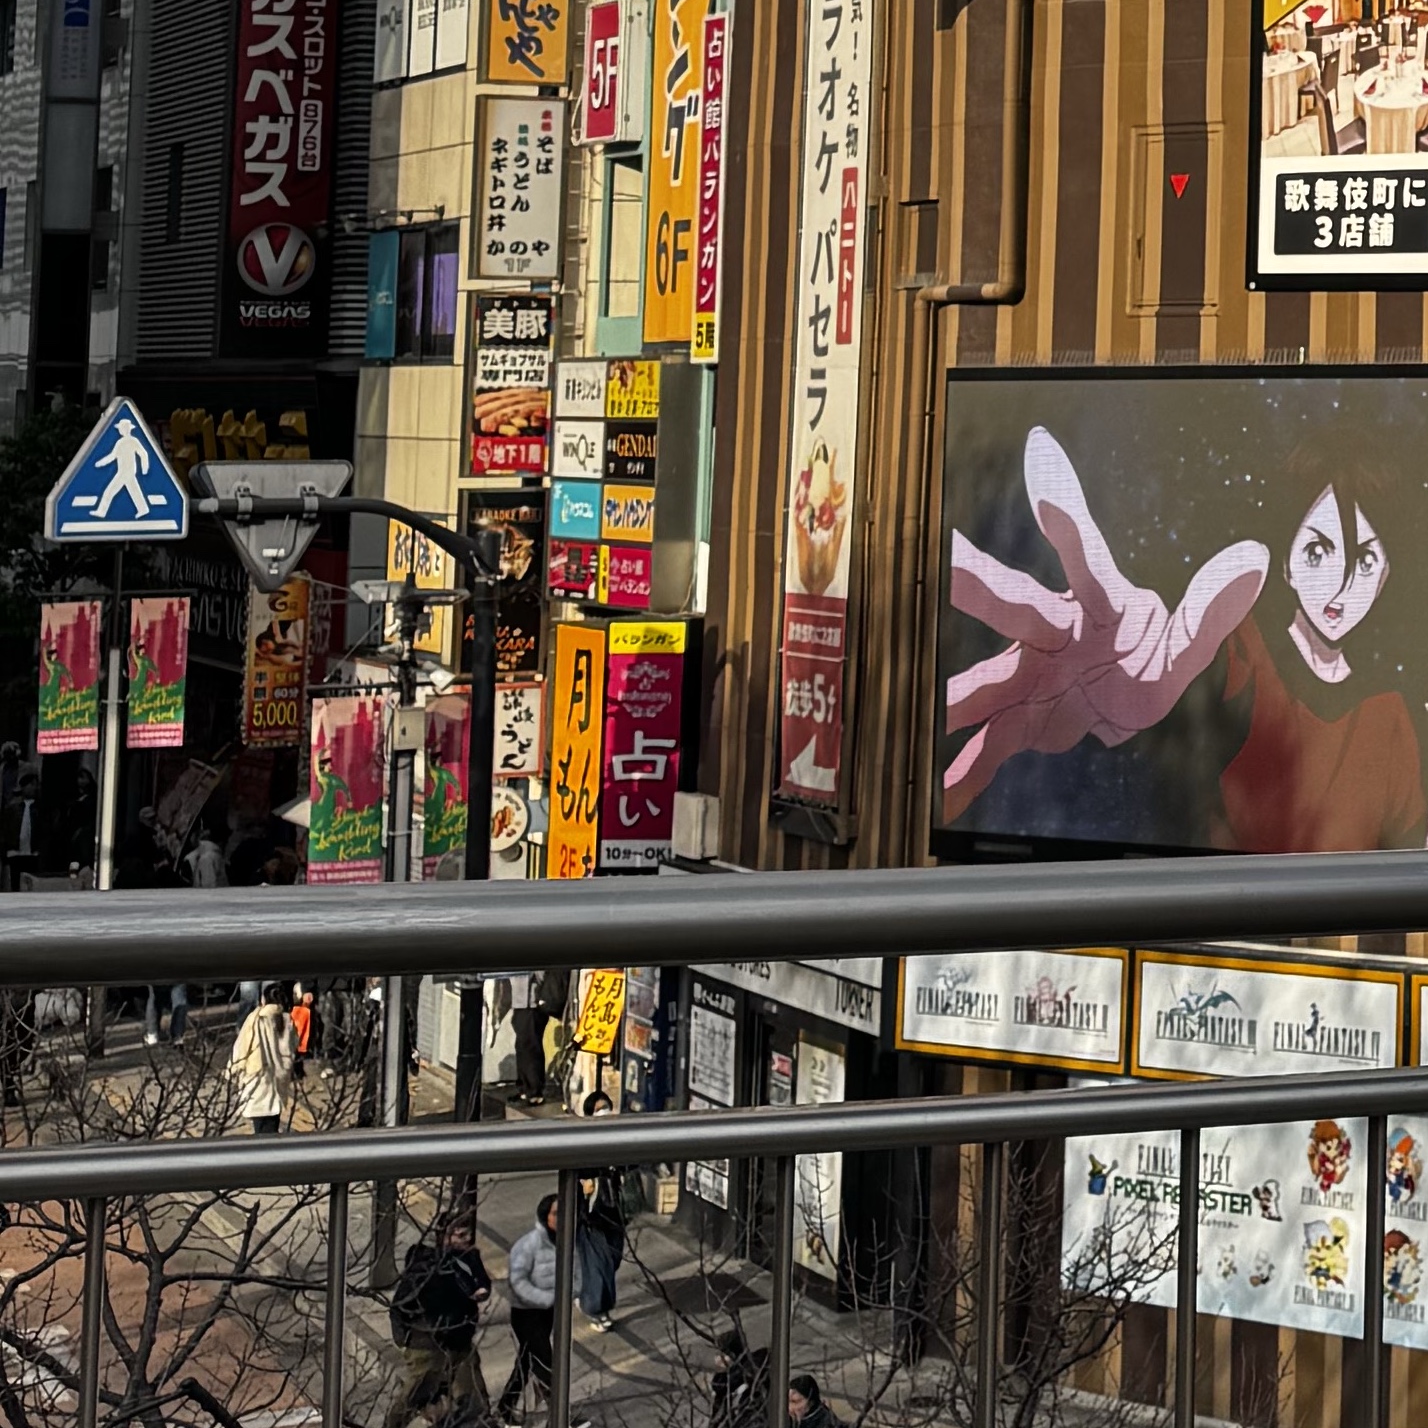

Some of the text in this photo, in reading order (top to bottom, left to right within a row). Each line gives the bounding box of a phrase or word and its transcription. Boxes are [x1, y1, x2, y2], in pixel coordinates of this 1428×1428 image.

[590, 36, 619, 110] 5F
[536, 136, 556, 174] そば
[699, 29, 723, 305] 占い館バランガン
[511, 152, 530, 212] うどん
[1284, 177, 1427, 212] 歌舞伎町に
[487, 239, 550, 256] かのや
[1313, 212, 1395, 250] 3店舗
[504, 257, 531, 273] 1F
[655, 212, 691, 296] 6F
[240, 305, 311, 318] VEGAS
[483, 308, 547, 340] 美豚
[805, 218, 838, 432] パセラ
[252, 701, 297, 728] 5,000
[611, 730, 677, 827] 占い
[1112, 1175, 1159, 1203] PIXEL
